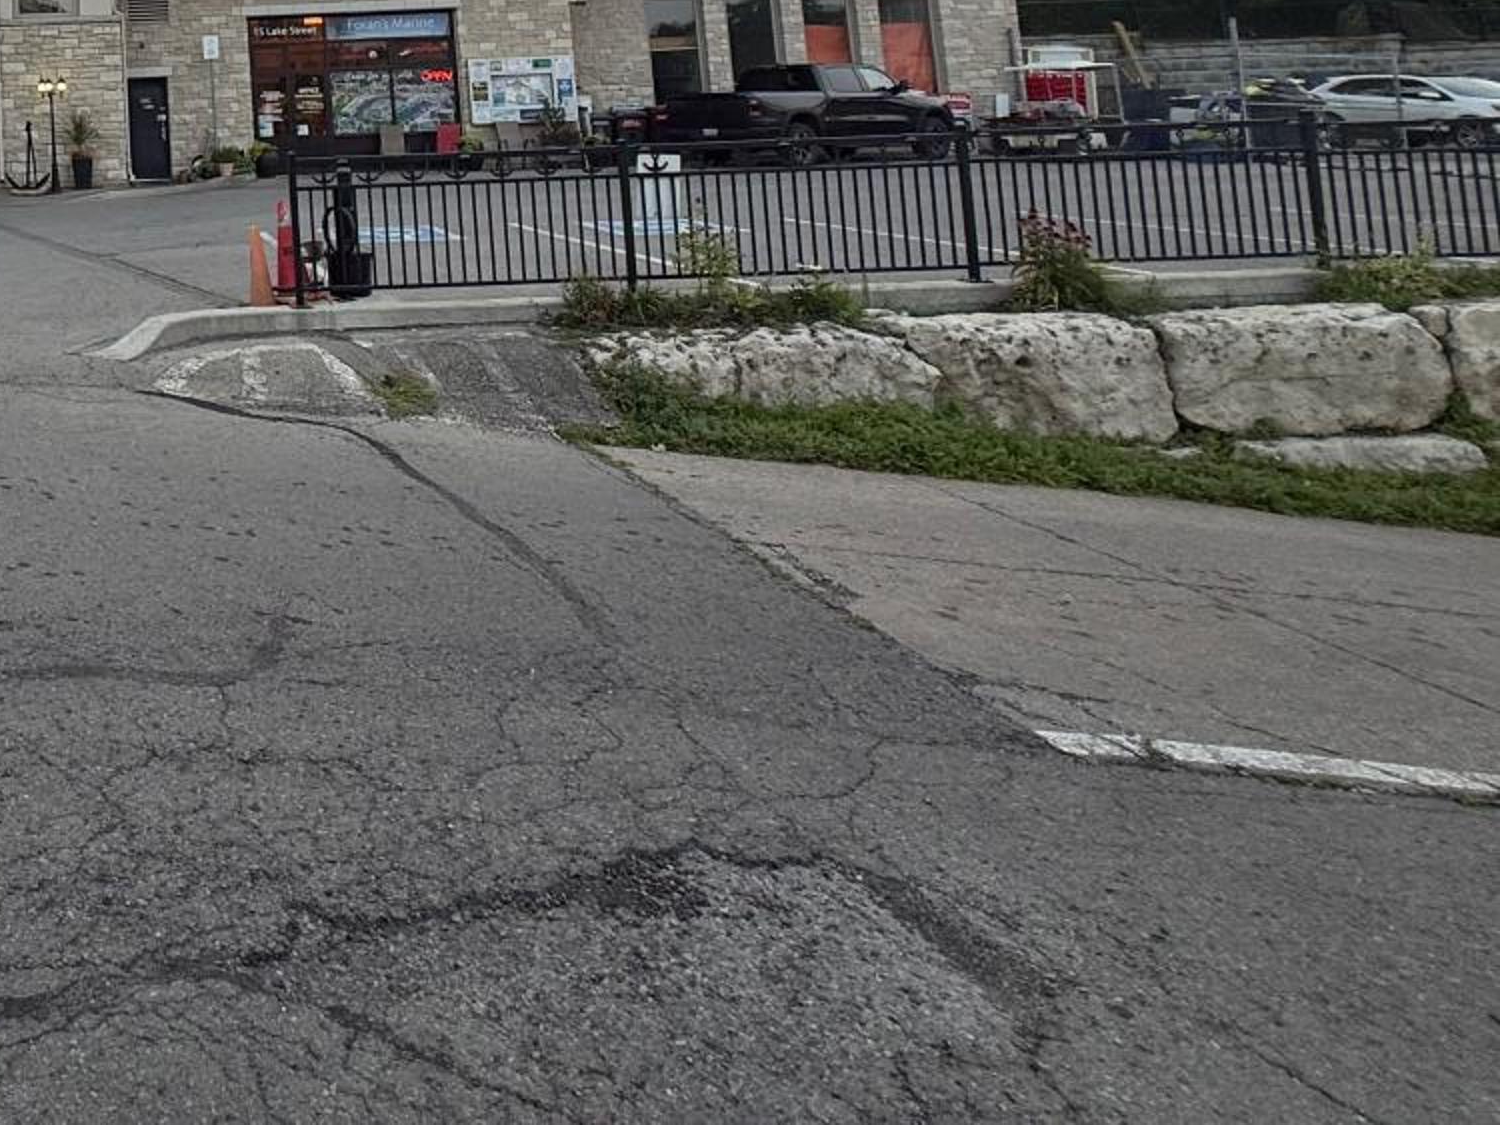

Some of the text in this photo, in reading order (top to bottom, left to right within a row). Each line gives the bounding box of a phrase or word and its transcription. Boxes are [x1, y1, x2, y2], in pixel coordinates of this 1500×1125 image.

[391, 16, 435, 29] Marine
[266, 26, 288, 36] Lake
[289, 26, 317, 36] Street
[420, 69, 453, 82] OPEN
